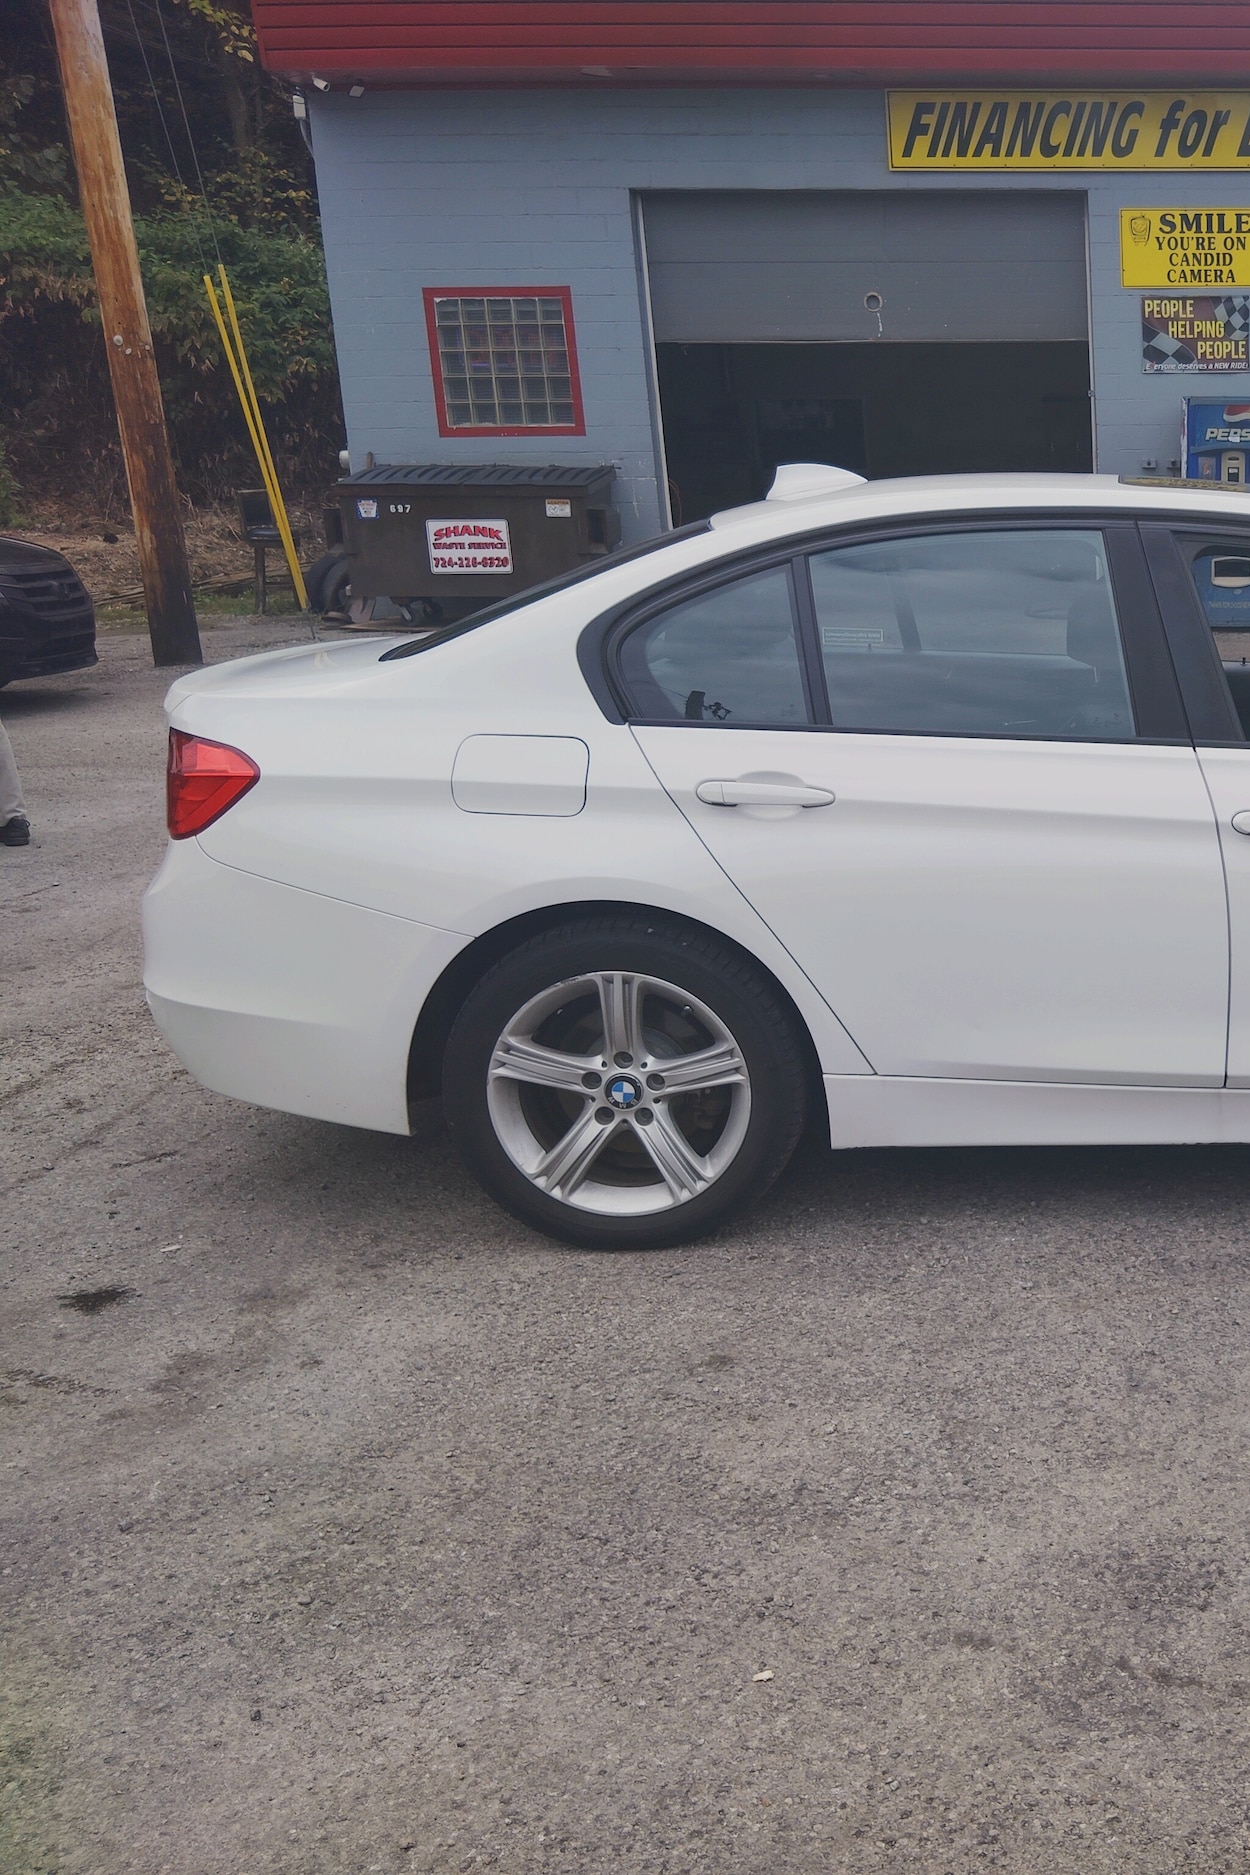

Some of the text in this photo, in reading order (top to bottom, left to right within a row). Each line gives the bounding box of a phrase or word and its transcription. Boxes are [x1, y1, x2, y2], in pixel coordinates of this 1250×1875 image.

[901, 99, 1142, 159] FINANCING
[1155, 98, 1231, 158] for
[1155, 236, 1247, 251] YOU'RE ON
[1169, 252, 1233, 267] CANDID
[1166, 269, 1236, 283] CAMERA
[1144, 299, 1194, 319] PEOPLE
[1168, 320, 1225, 339] HELPING
[1197, 340, 1246, 360] PEOPLE
[1214, 361, 1230, 369] NEW
[434, 525, 504, 541] SHANK
